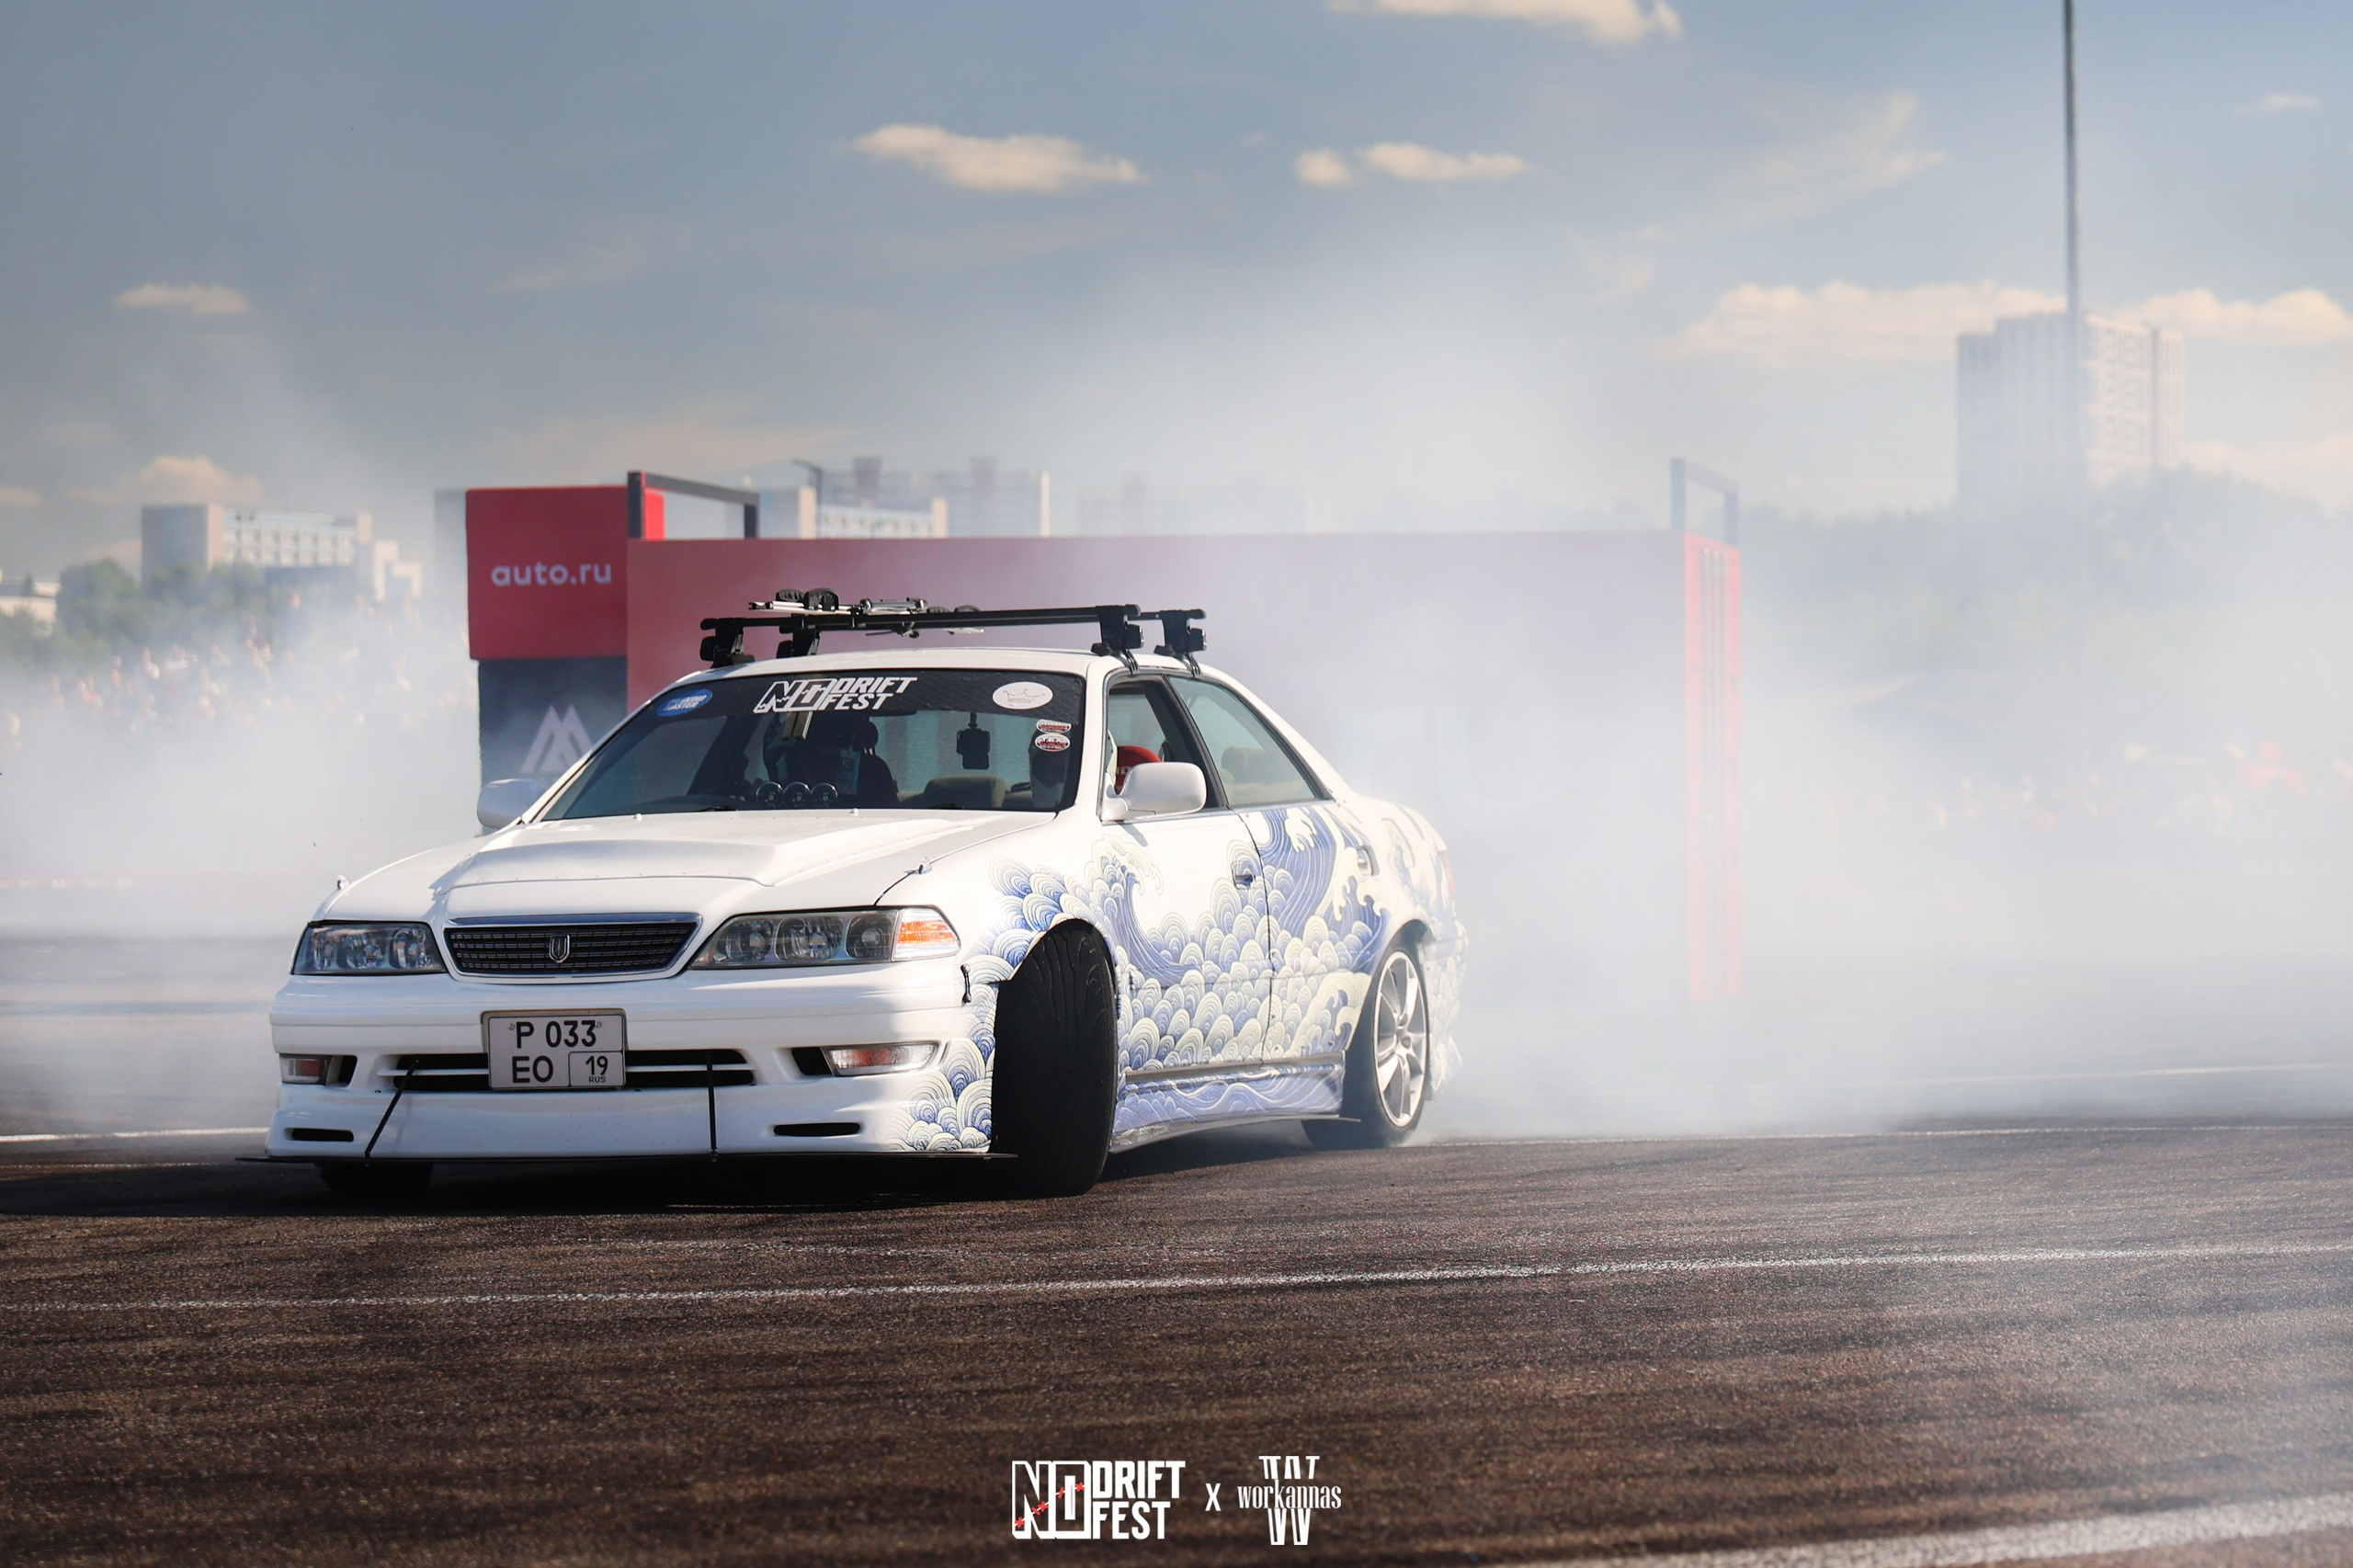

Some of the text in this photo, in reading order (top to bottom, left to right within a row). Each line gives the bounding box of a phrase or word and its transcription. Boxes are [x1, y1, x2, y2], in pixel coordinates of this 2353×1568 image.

[491, 562, 612, 586] auto.ru
[829, 676, 917, 694] DRIFT
[818, 693, 893, 711] FEST
[545, 1019, 597, 1048] 033
[585, 1055, 608, 1075] 19
[588, 1075, 607, 1084] RUS
